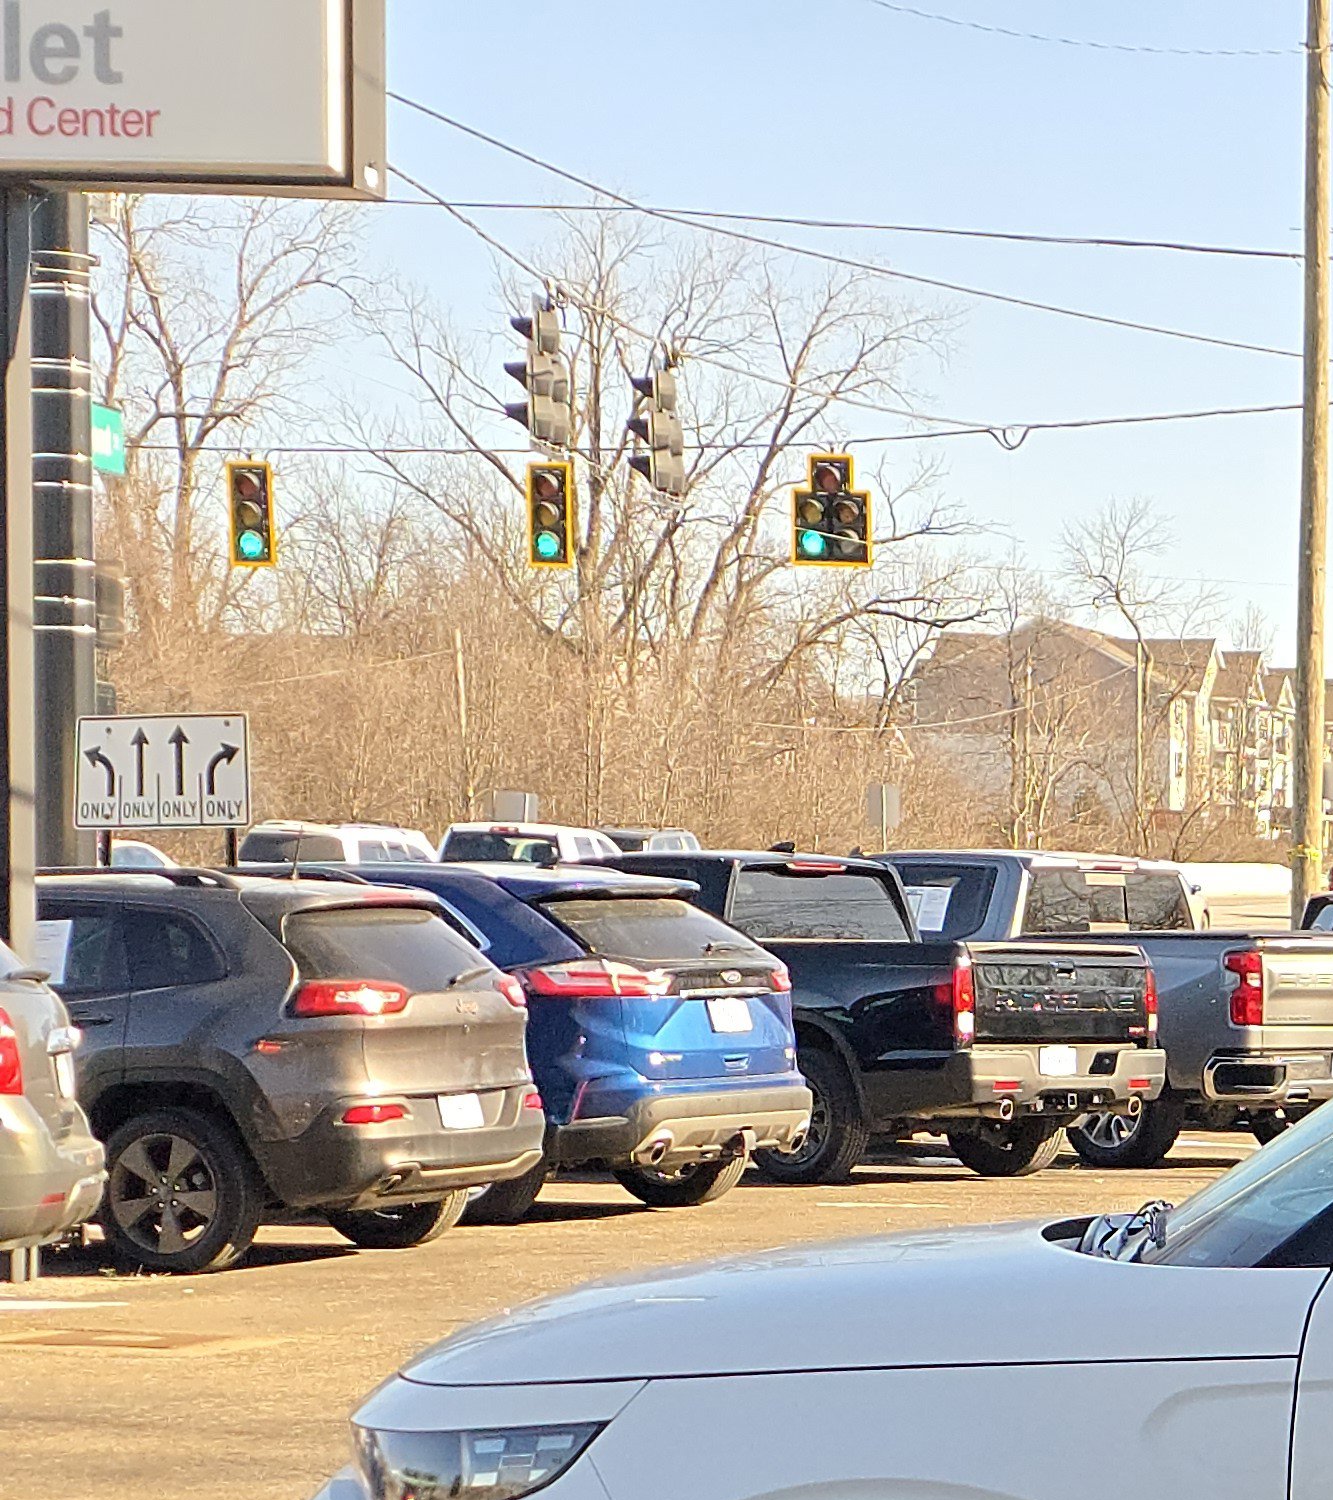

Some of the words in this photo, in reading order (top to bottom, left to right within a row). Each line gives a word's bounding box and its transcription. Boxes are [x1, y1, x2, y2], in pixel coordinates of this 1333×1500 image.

[4, 0, 124, 85] let
[27, 96, 161, 137] Center
[81, 802, 116, 819] ONLY
[123, 802, 155, 818] ONLY
[162, 801, 197, 818] ONLY
[206, 800, 243, 818] ONLY
